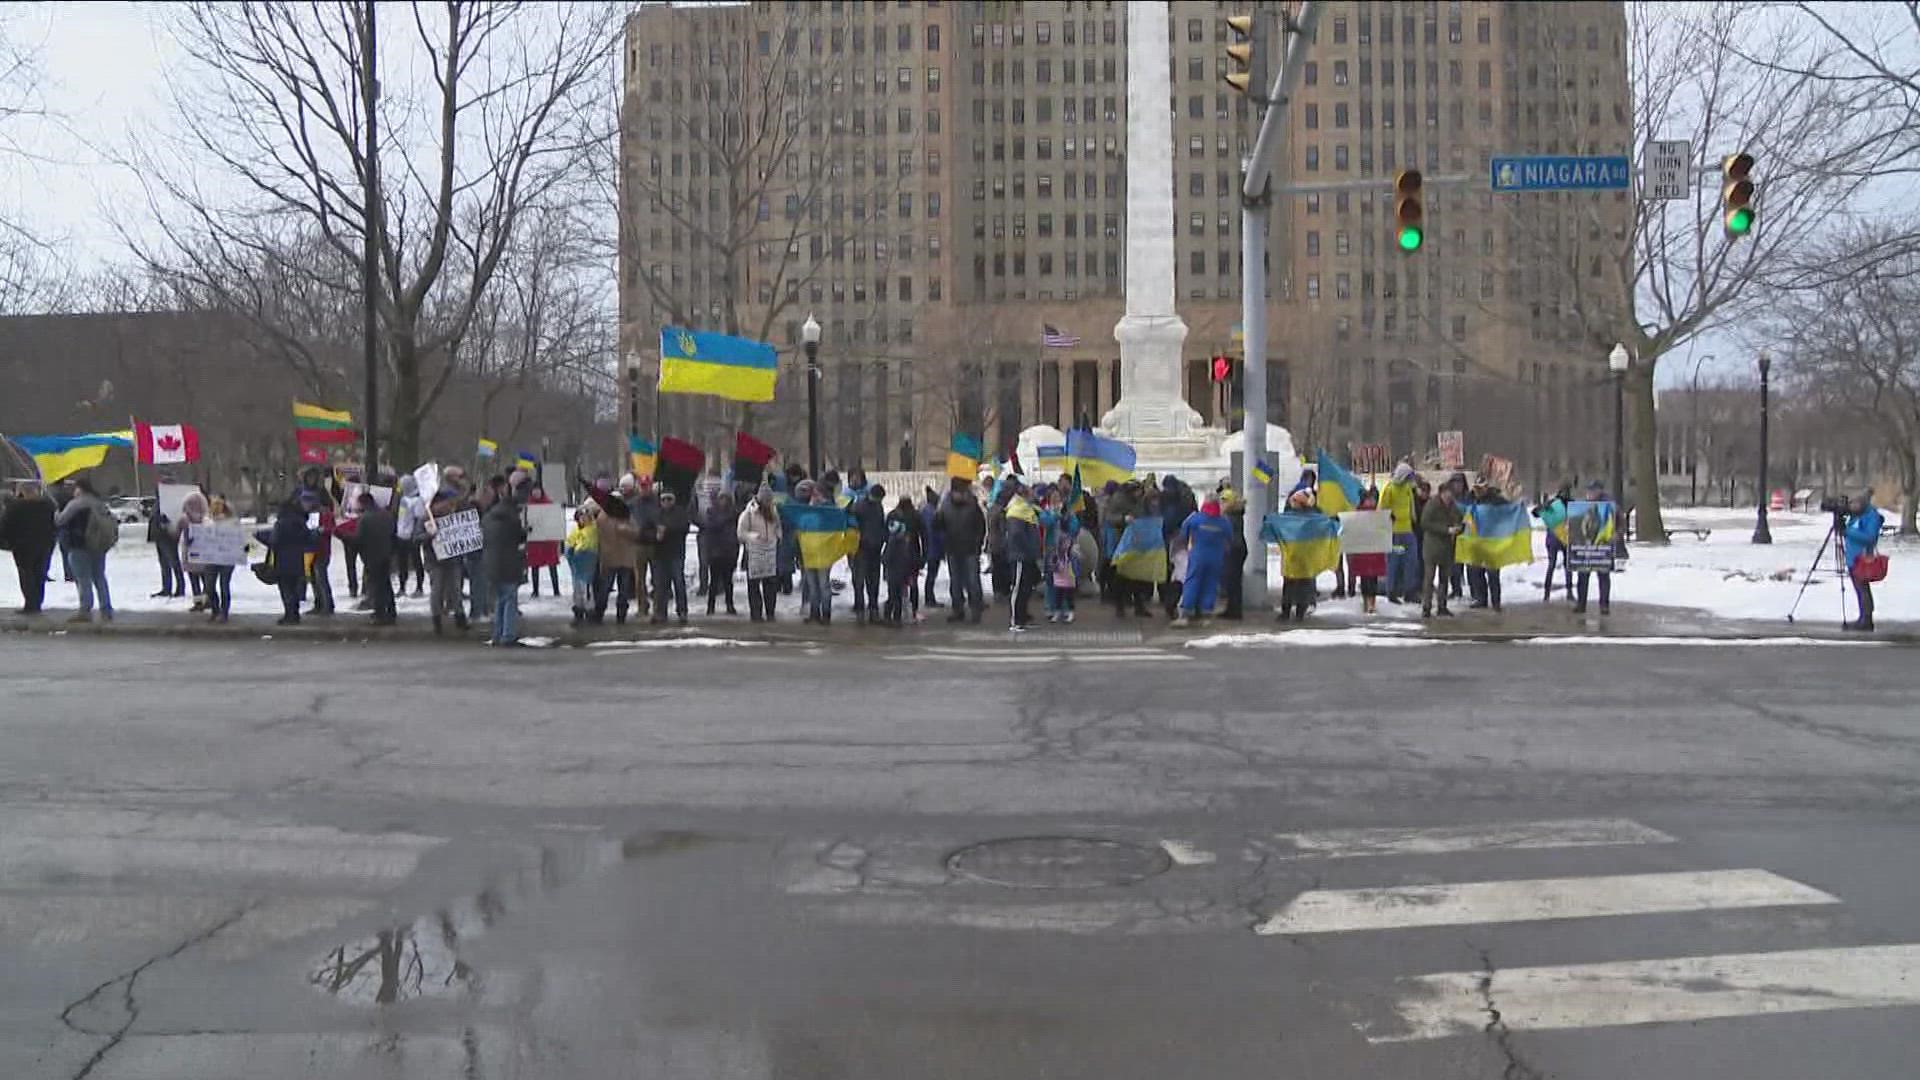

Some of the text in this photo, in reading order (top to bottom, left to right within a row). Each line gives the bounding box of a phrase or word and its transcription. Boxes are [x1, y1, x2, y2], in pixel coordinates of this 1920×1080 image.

[1659, 143, 1675, 155] NO
[1654, 157, 1681, 169] TURN
[1525, 162, 1611, 184] NIAGARA
[1659, 172, 1675, 184] ON
[1655, 185, 1679, 197] RED
[436, 511, 478, 529] BUFFALO
